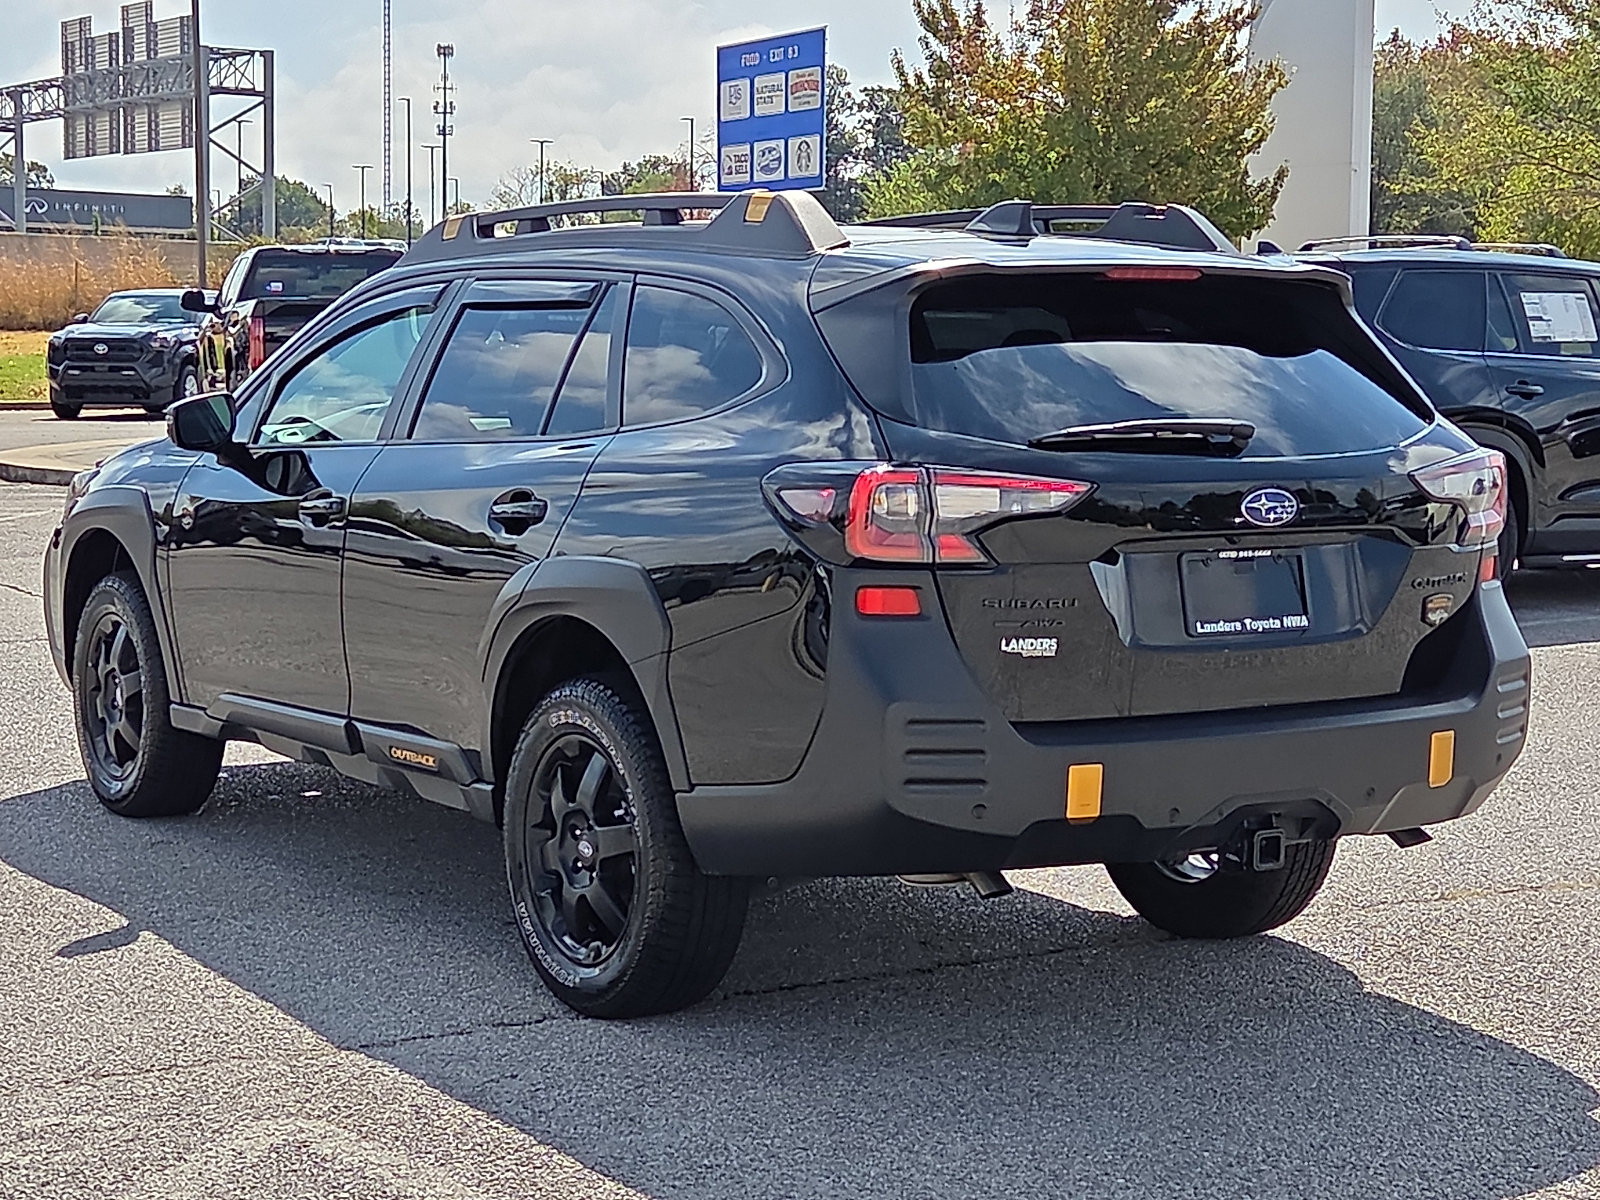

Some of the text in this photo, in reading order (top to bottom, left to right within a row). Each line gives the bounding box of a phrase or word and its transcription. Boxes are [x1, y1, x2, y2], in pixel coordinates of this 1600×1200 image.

[741, 52, 760, 67] FOOD
[769, 47, 785, 62] EXIT
[733, 153, 749, 163] TACO
[54, 202, 125, 213] INFINITI
[982, 597, 1079, 610] SUBARU
[1196, 615, 1309, 633] Landers Toyota NWA
[1000, 637, 1058, 652] LANDERS
[390, 742, 437, 768] OUTBACK
